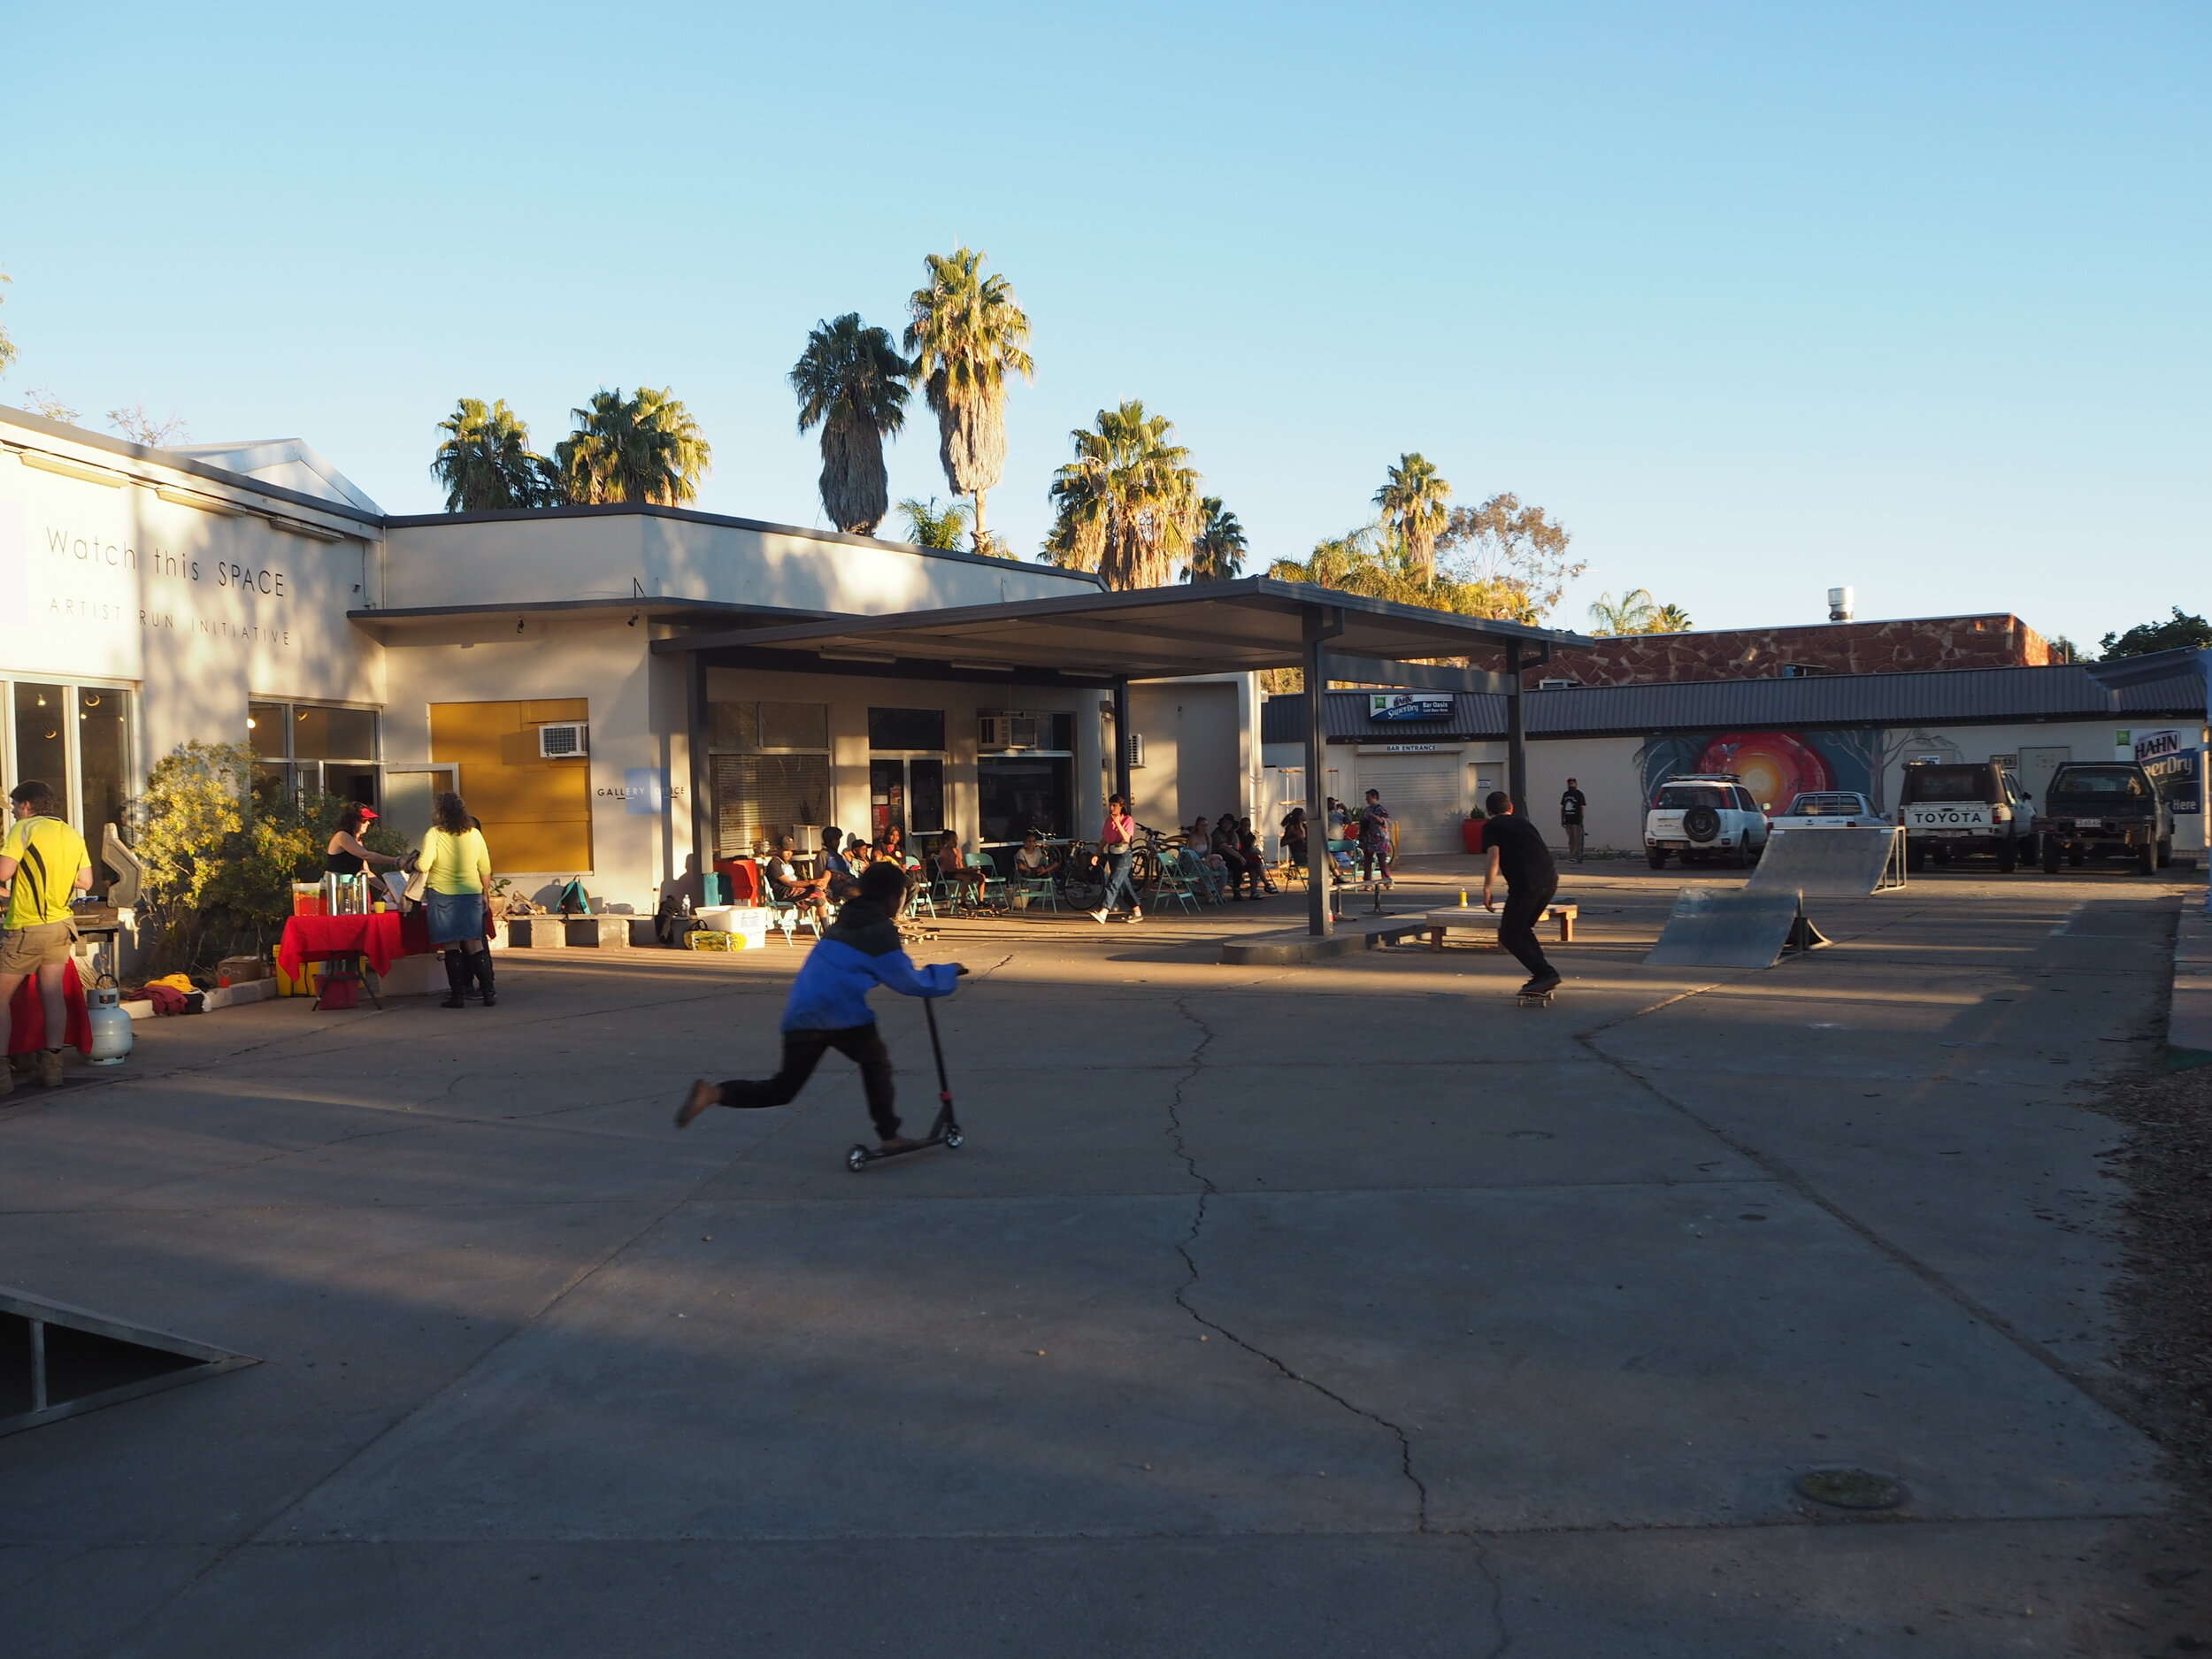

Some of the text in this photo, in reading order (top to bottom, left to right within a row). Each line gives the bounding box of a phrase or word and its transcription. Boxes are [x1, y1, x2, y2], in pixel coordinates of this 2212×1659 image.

[46, 526, 284, 597] Watch this SPACE
[50, 598, 289, 646] ARTIST RUN INITIATIVE
[1387, 704, 1418, 719] SuperDry
[2134, 735, 2178, 760] HAHN
[2144, 757, 2192, 777] erDry
[597, 787, 644, 796] GALLERY
[2172, 799, 2197, 810] Here
[1915, 812, 1982, 823] TOYOTA
